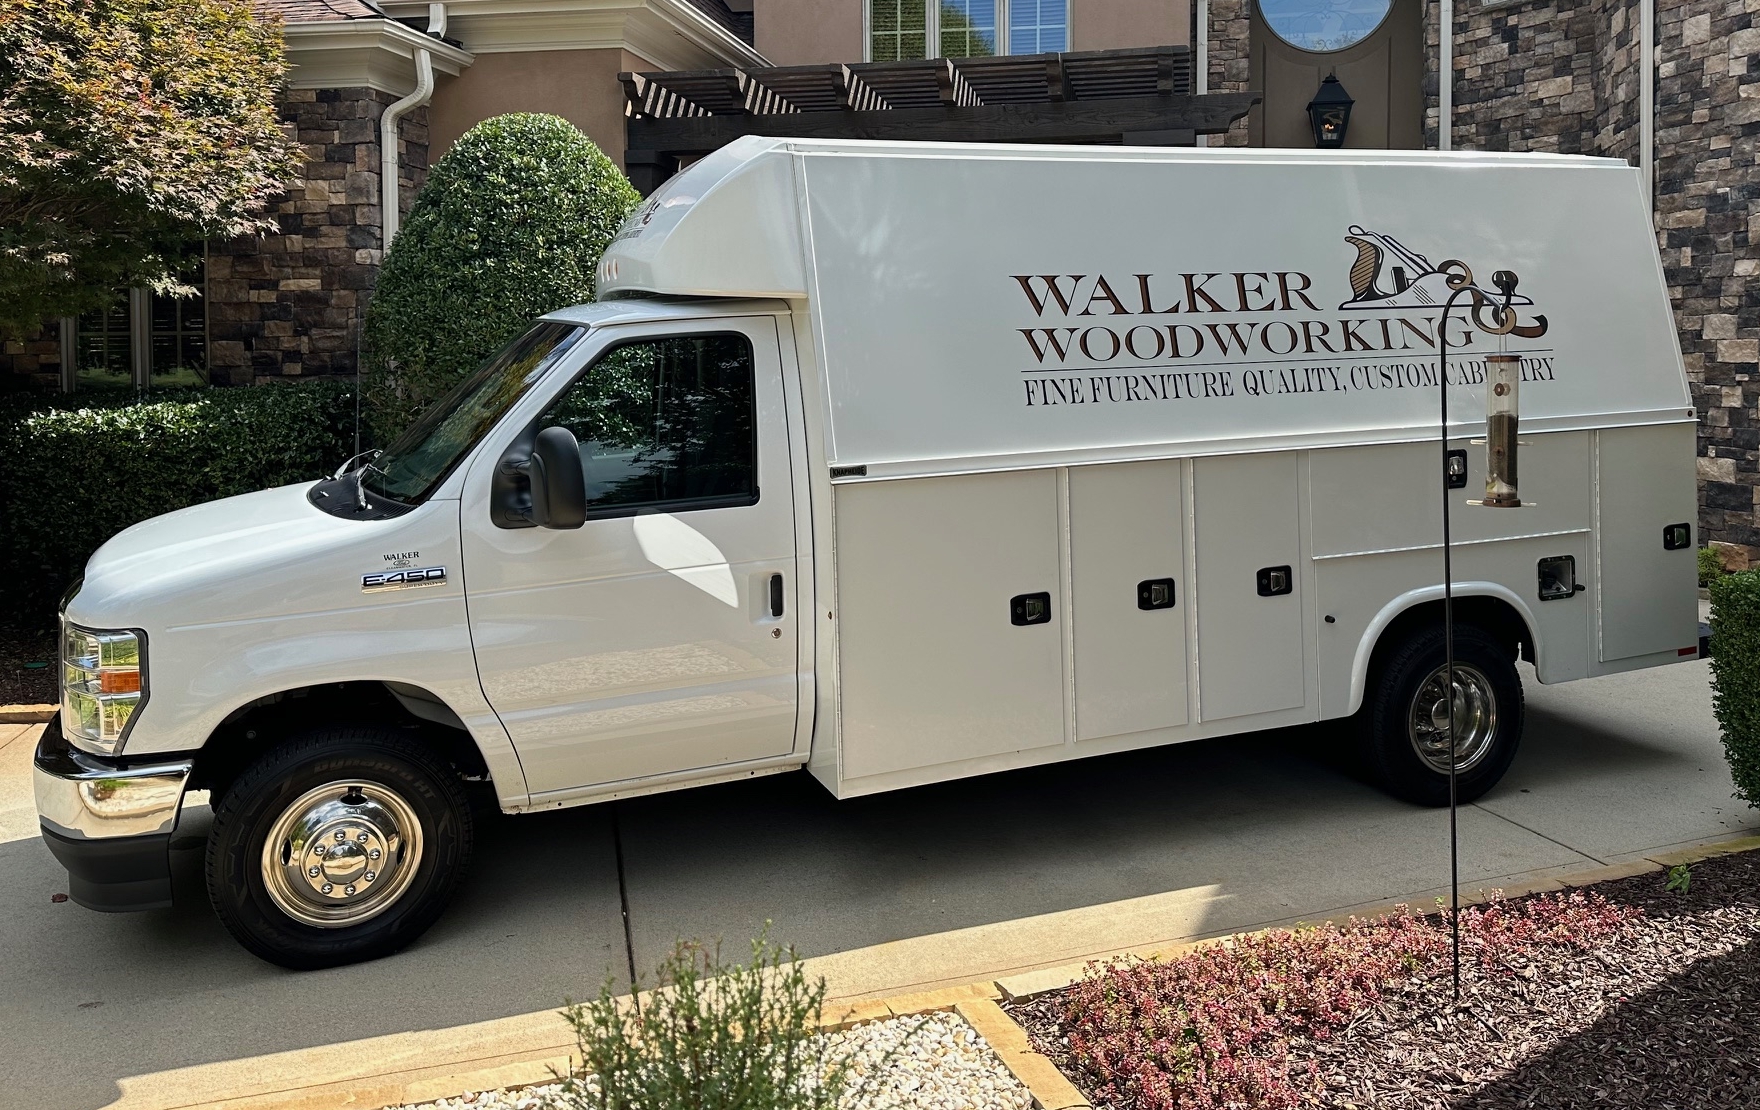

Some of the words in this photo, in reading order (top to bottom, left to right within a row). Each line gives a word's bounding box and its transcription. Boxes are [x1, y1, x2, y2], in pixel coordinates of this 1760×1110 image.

[1008, 271, 1325, 318] WALKER
[1015, 315, 1474, 364] WOODWORKING
[1022, 377, 1085, 406] FINE
[1088, 371, 1235, 403] FURNITURE
[1242, 366, 1347, 397] QUALITY,
[1350, 361, 1440, 391] CUSTOM
[1446, 356, 1556, 386] CABITRY
[362, 568, 445, 587] E-450
[383, 551, 420, 562] WALKER
